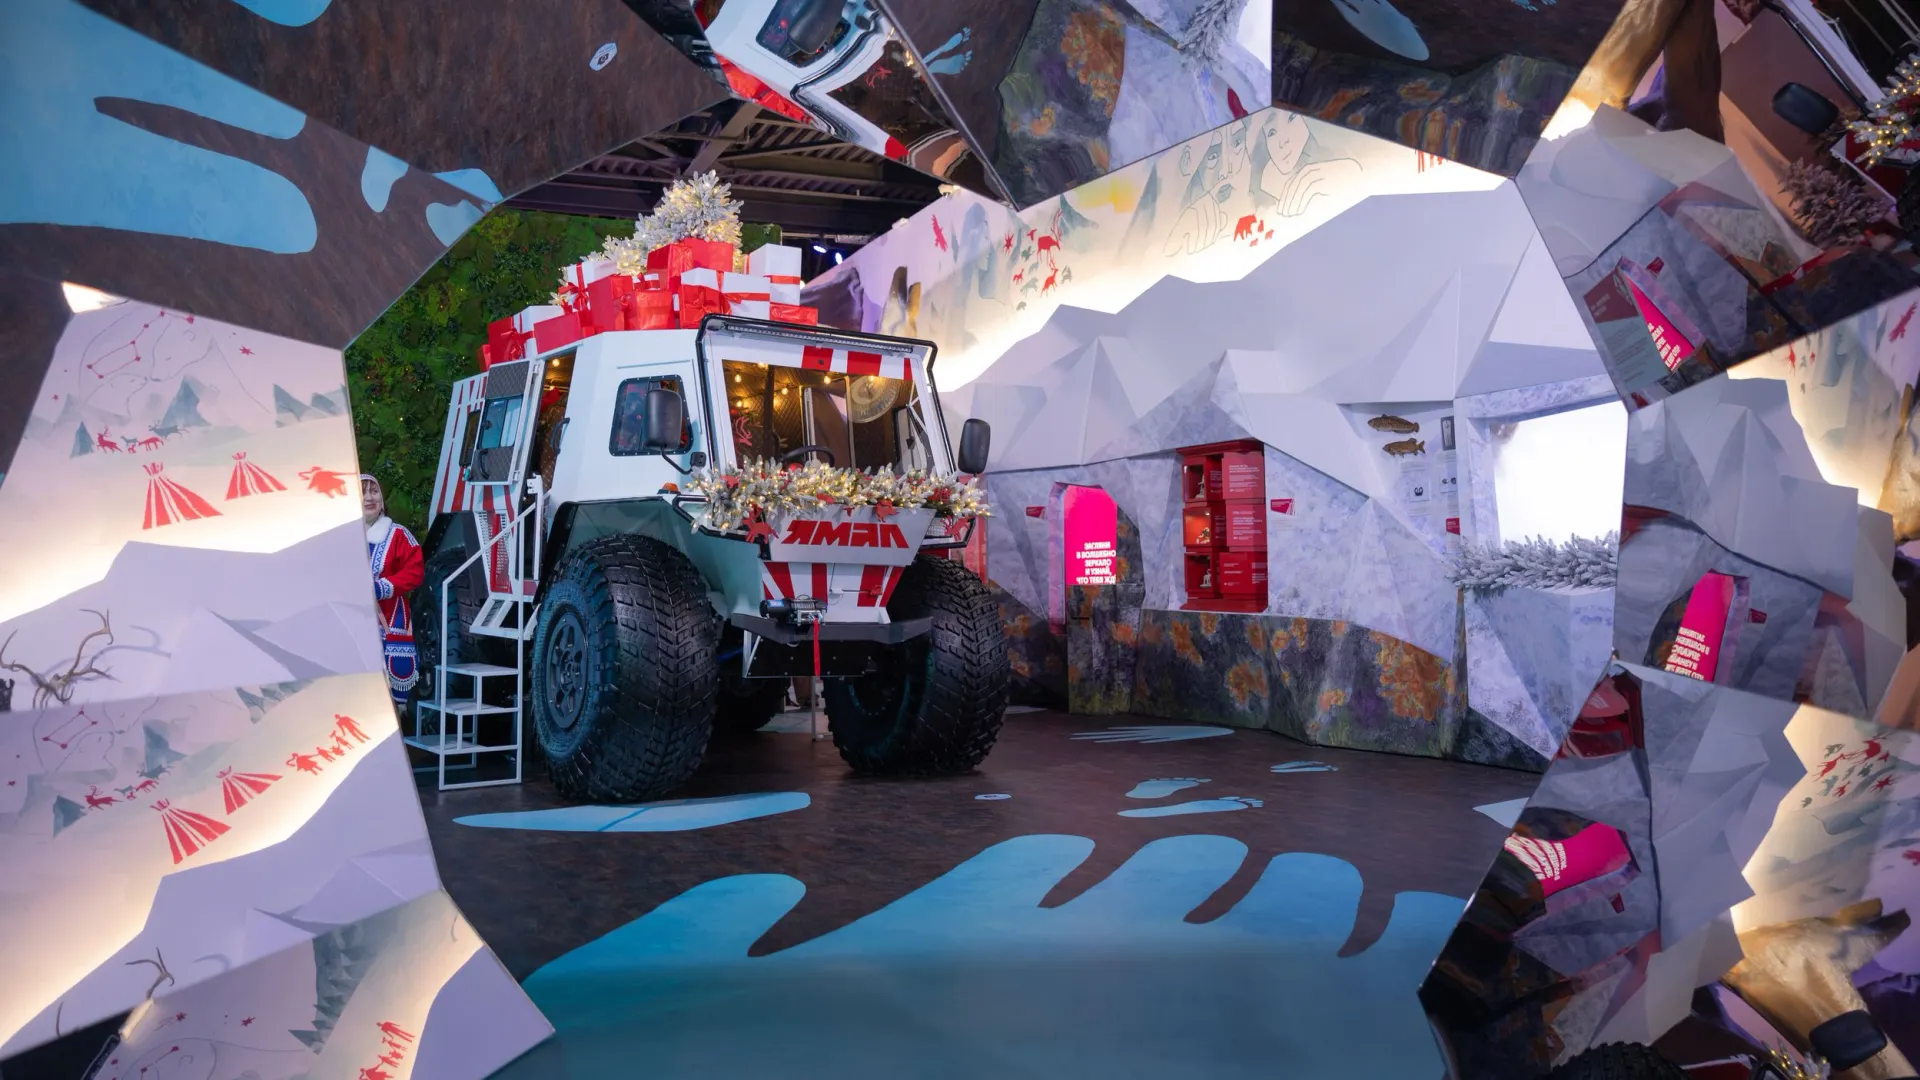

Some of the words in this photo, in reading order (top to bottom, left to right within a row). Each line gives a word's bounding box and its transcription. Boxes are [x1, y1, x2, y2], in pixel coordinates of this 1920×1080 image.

[781, 520, 909, 549] ЯМАЛ
[1076, 551, 1081, 559] В
[1084, 558, 1112, 567] ЗЕРКАЛО
[1085, 568, 1090, 576] И
[1076, 576, 1089, 584] ЧТО
